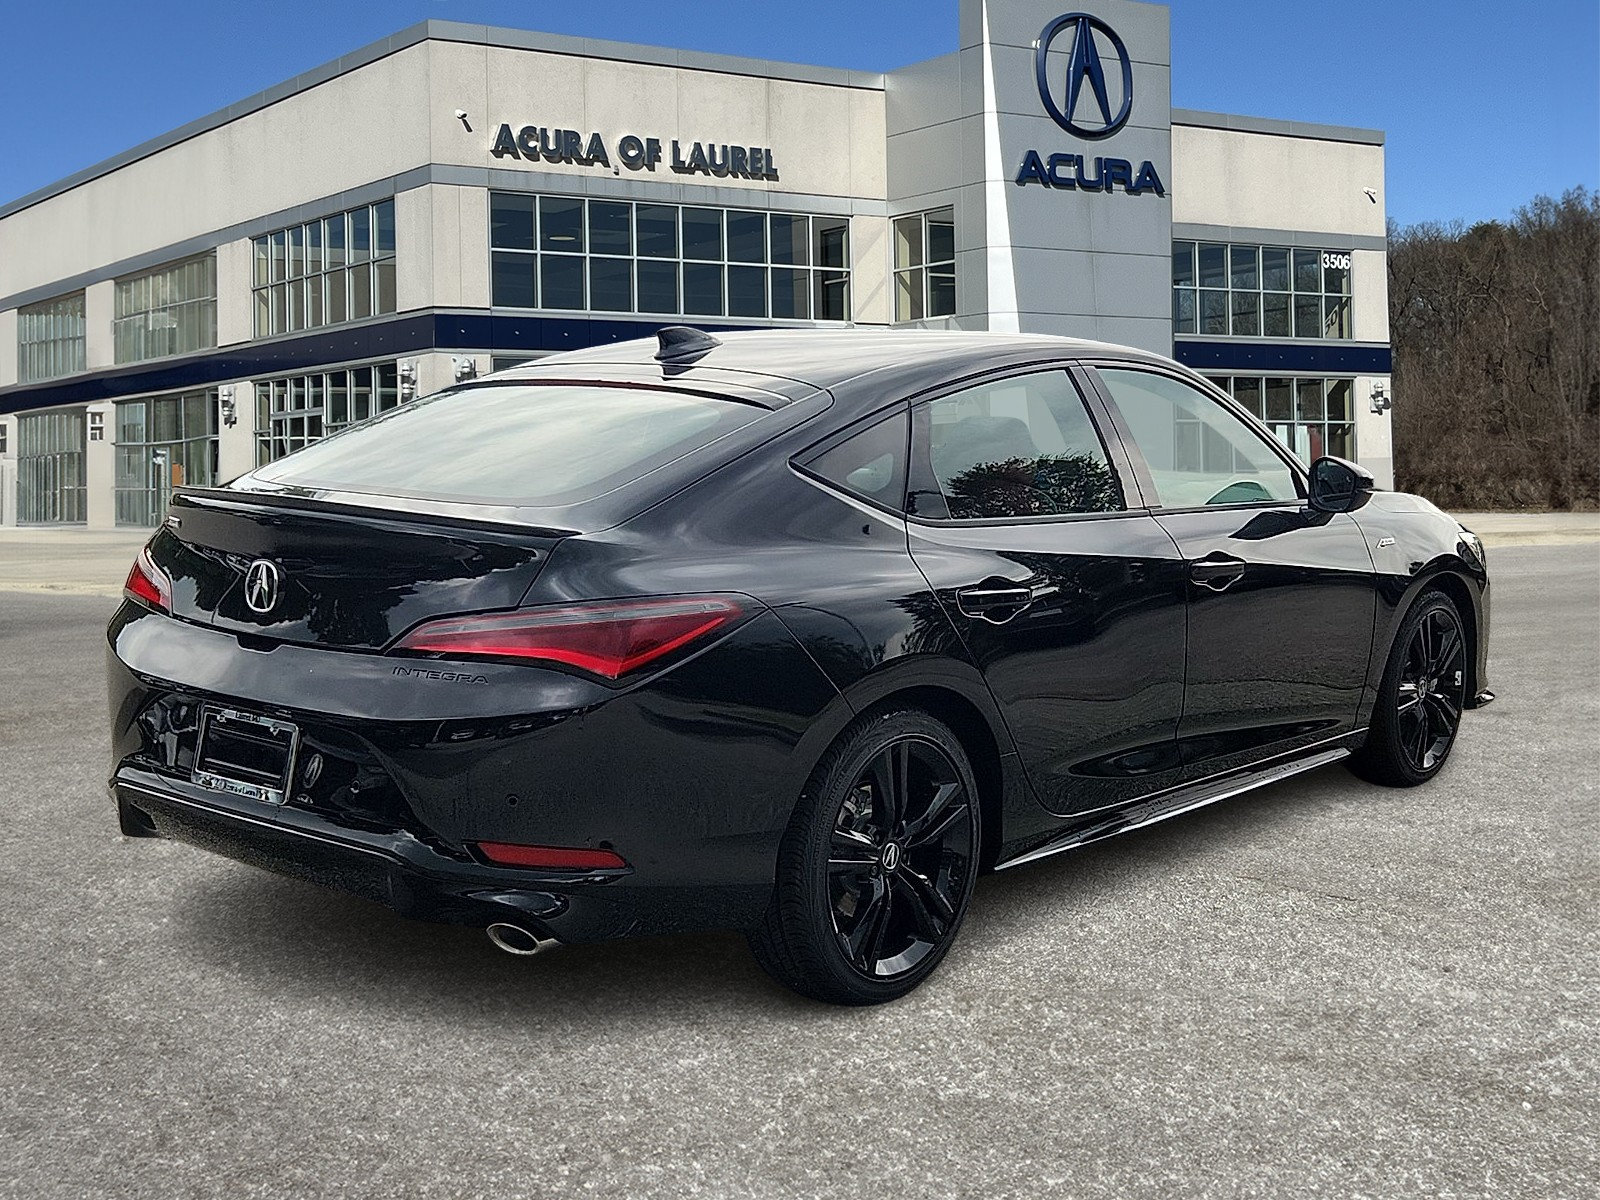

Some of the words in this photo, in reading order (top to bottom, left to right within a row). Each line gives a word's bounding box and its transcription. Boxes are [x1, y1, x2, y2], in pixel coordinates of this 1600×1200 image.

[491, 123, 610, 167] ACURA
[618, 135, 661, 172] OF
[671, 140, 779, 181] LAUREL
[1015, 150, 1165, 197] ACURA
[1322, 253, 1351, 270] 3506
[392, 666, 489, 684] INTEGRA
